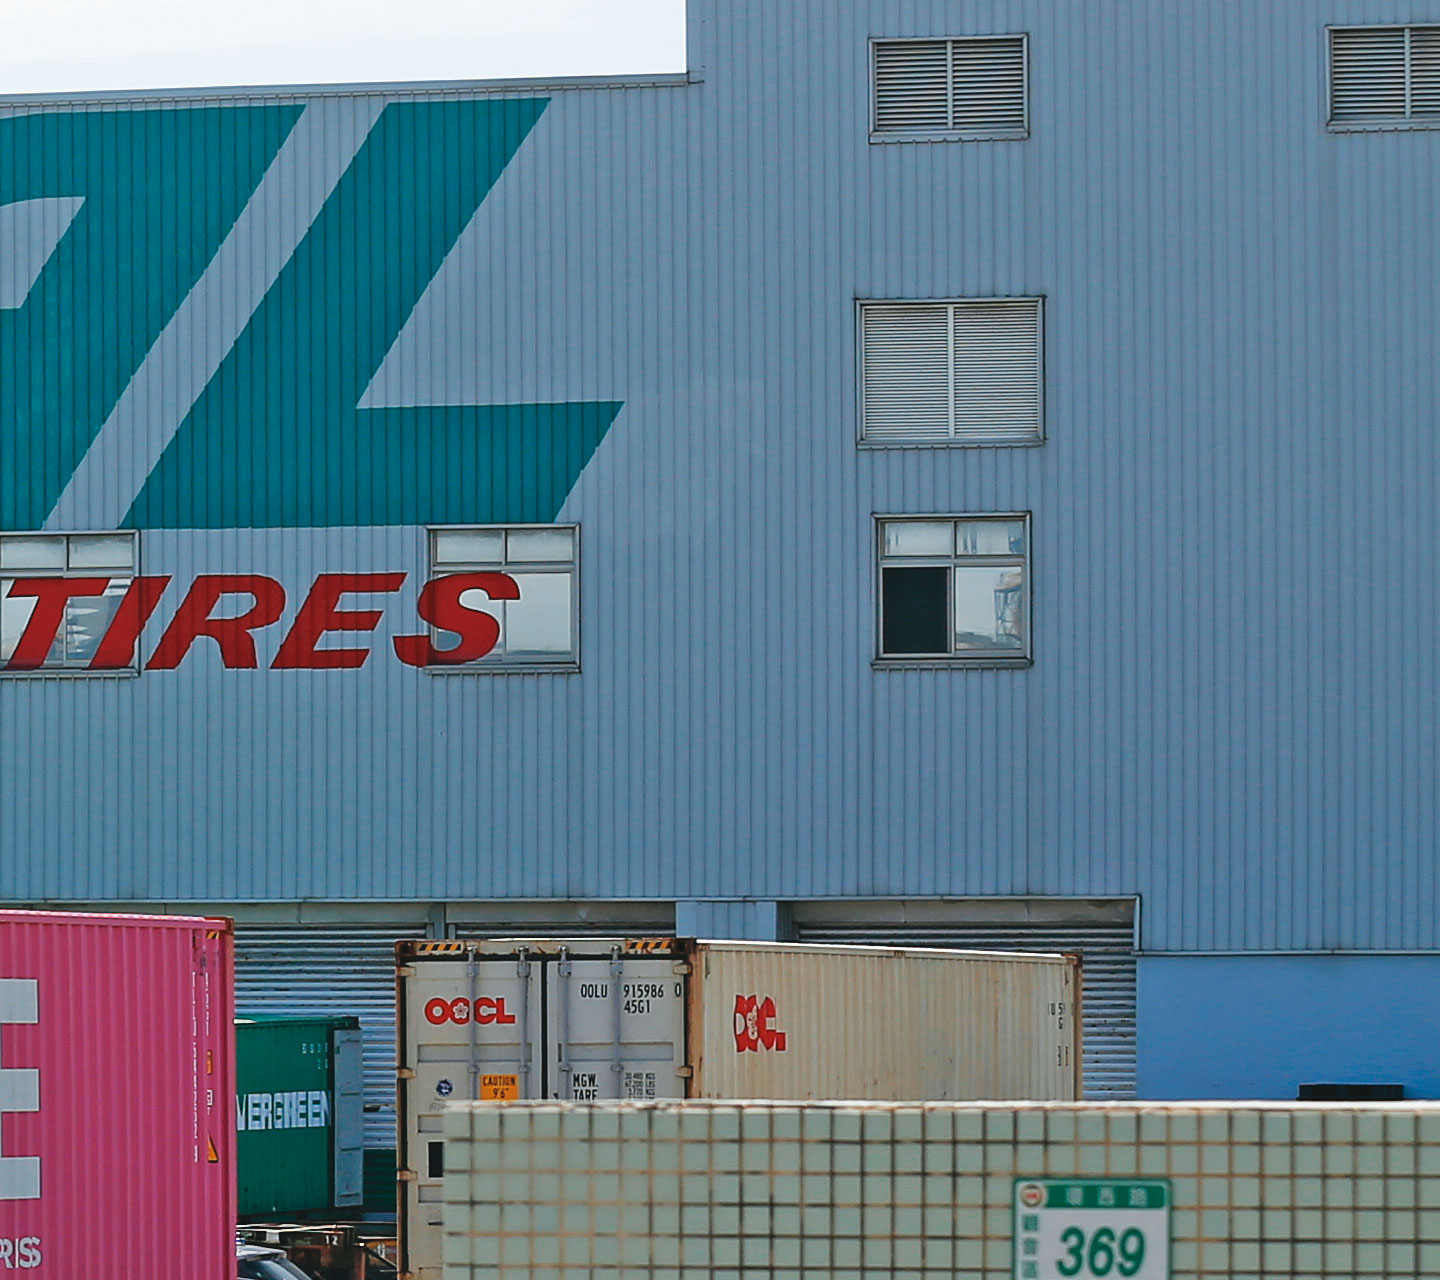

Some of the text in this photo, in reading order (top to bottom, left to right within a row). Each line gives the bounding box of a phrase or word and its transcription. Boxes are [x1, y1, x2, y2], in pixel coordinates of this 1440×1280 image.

[4, 571, 521, 671] TIRES
[623, 983, 664, 998] 915986
[425, 997, 516, 1025] OOCL
[624, 1000, 651, 1014] 45G1
[483, 1076, 516, 1087] CAUTION
[236, 1091, 331, 1131] VERGREEN
[1056, 1225, 1145, 1277] 369
